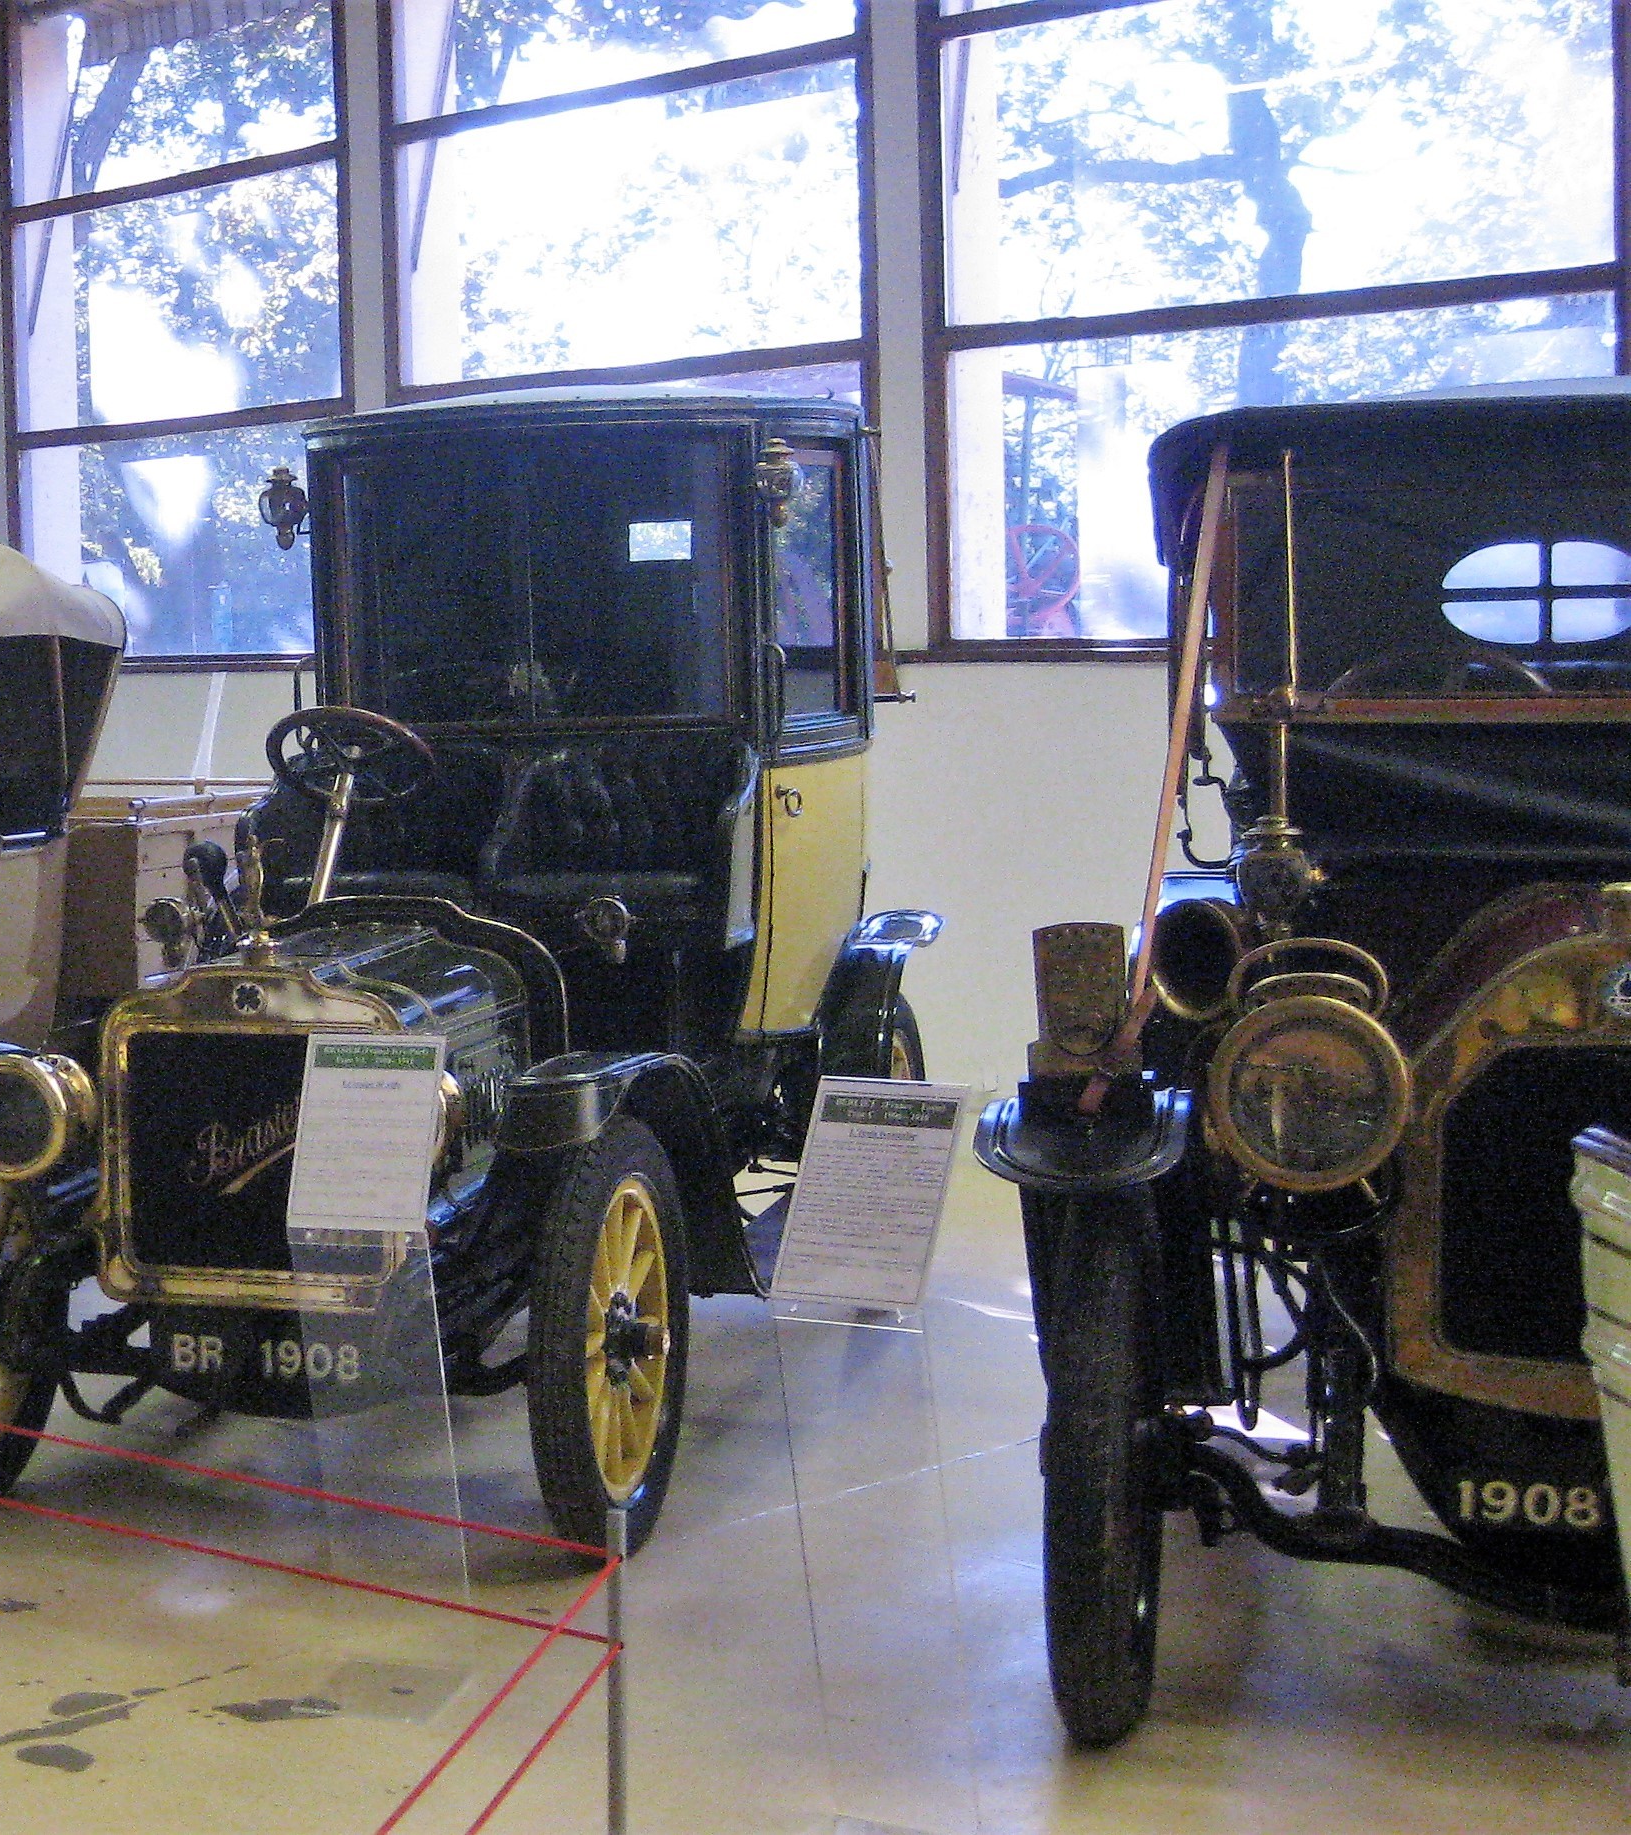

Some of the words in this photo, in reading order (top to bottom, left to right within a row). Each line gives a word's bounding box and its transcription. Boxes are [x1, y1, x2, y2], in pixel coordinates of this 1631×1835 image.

[172, 1333, 224, 1373] BR
[260, 1339, 361, 1381] 1908
[1457, 1478, 1602, 1530] 1908
